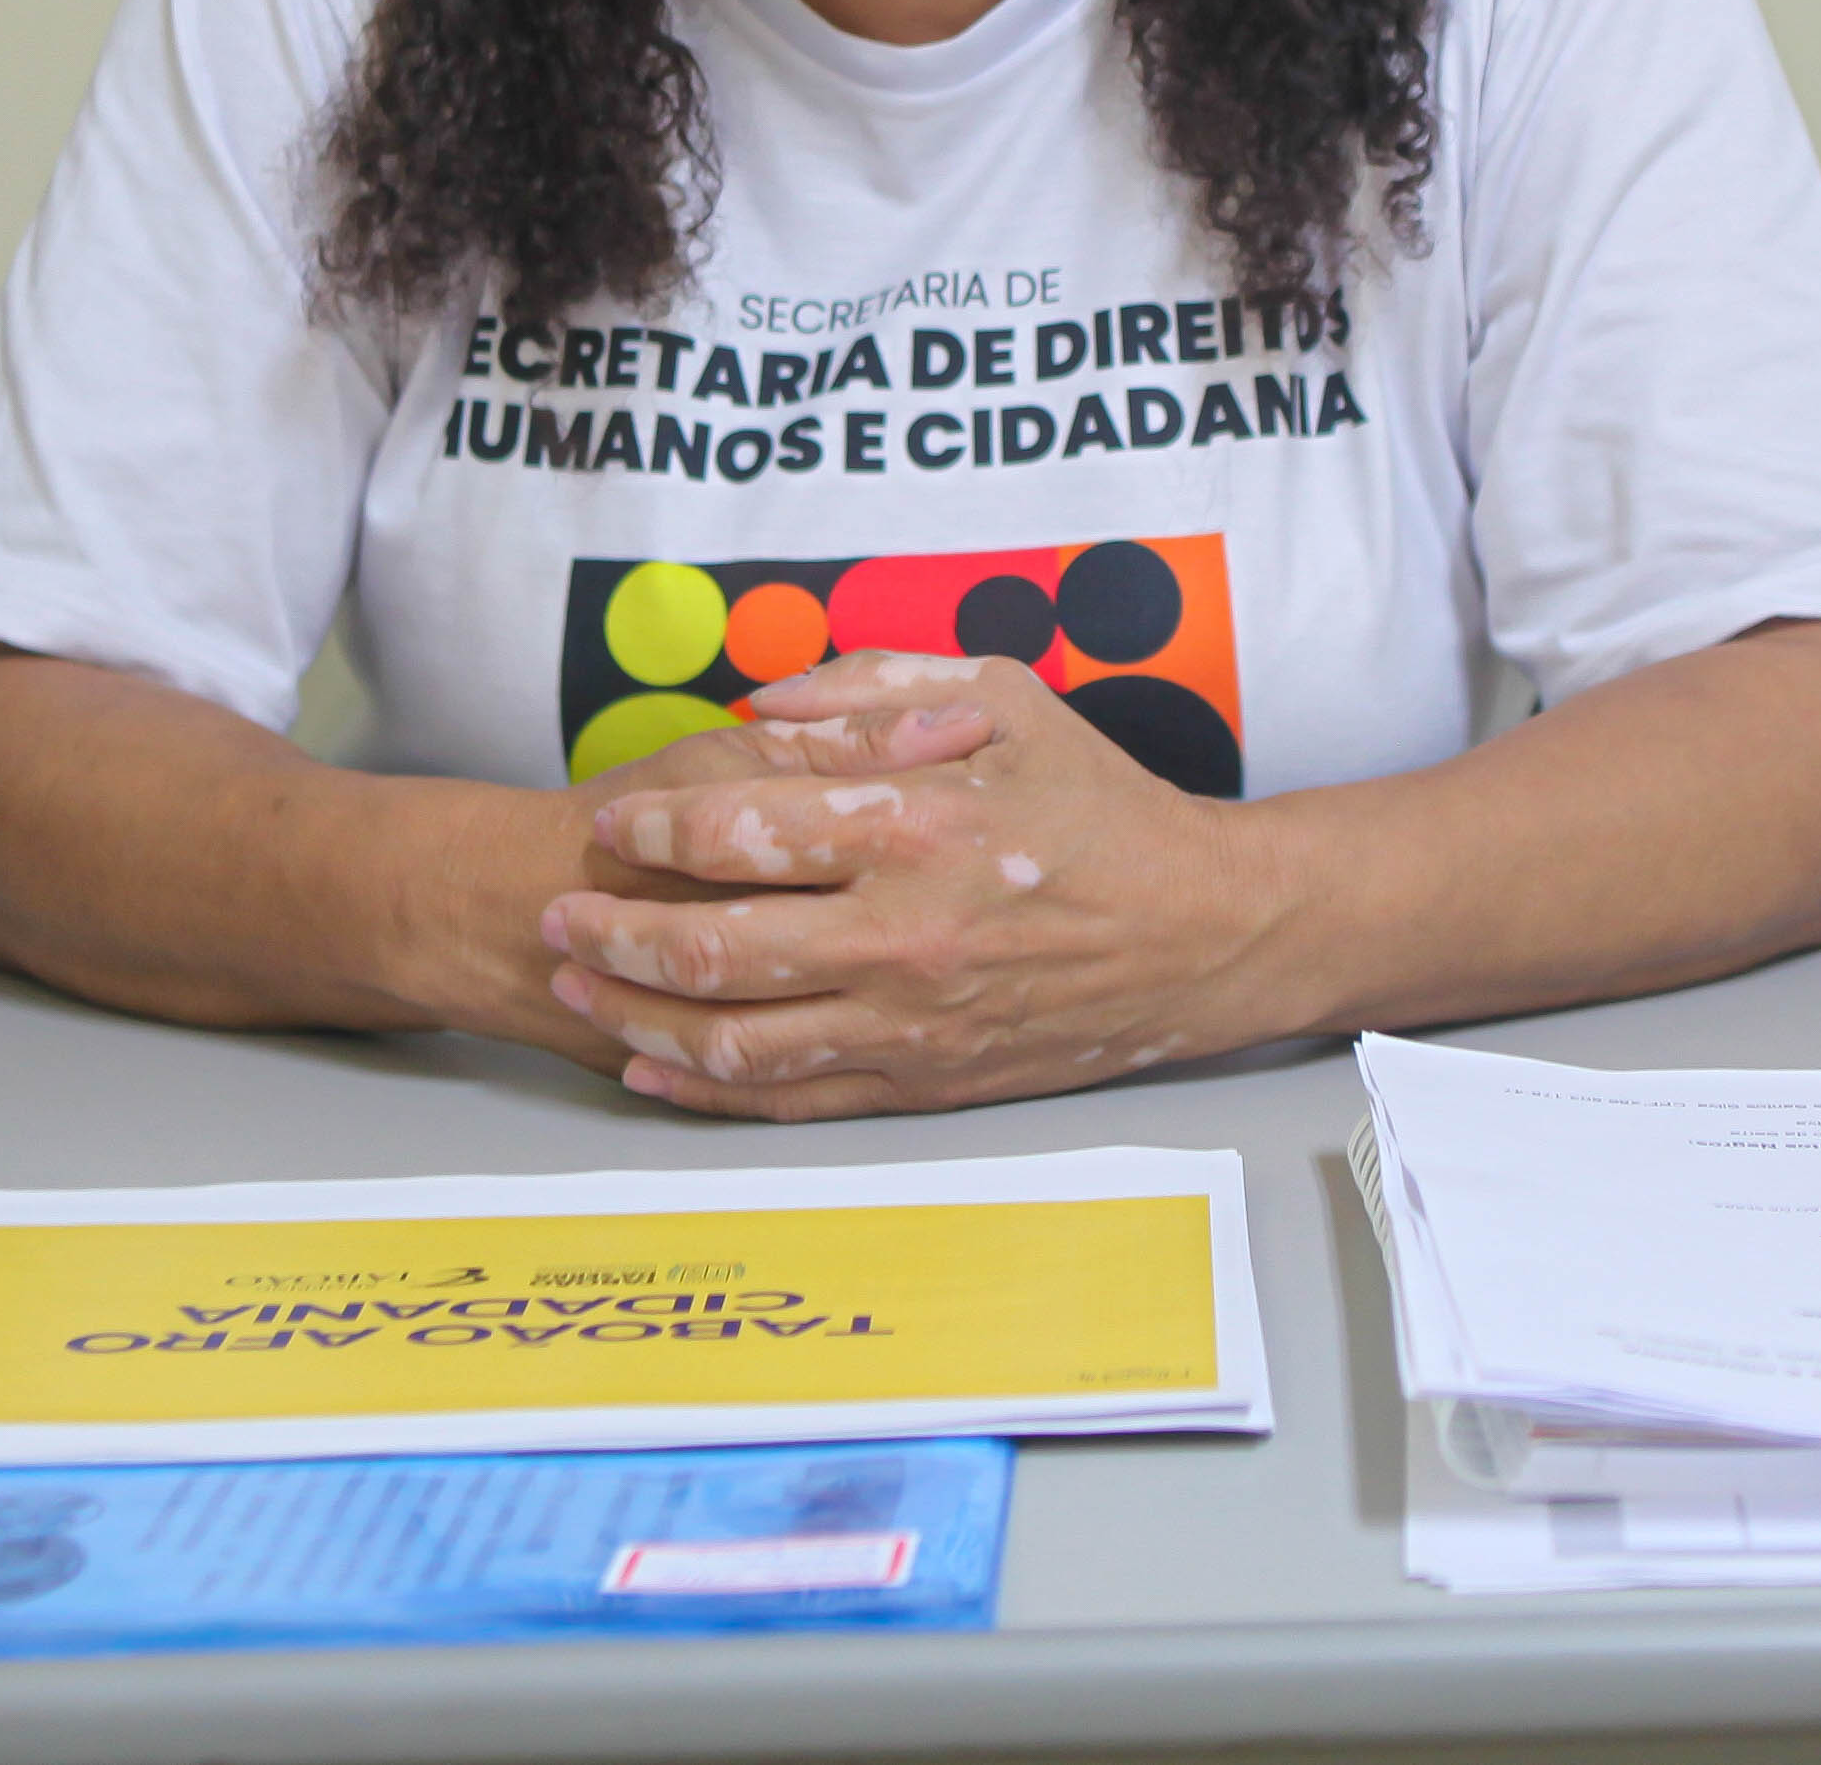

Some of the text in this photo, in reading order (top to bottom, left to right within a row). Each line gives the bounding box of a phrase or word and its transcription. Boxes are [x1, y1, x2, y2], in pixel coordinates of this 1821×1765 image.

[739, 267, 1062, 335] SECRETARIA DE
[463, 316, 892, 407] ECRETARIA
[911, 327, 1016, 390] DE
[844, 411, 888, 474] E
[65, 1314, 895, 1356] TABOÃO AFRO
[177, 1290, 808, 1326] CIDADANIA
